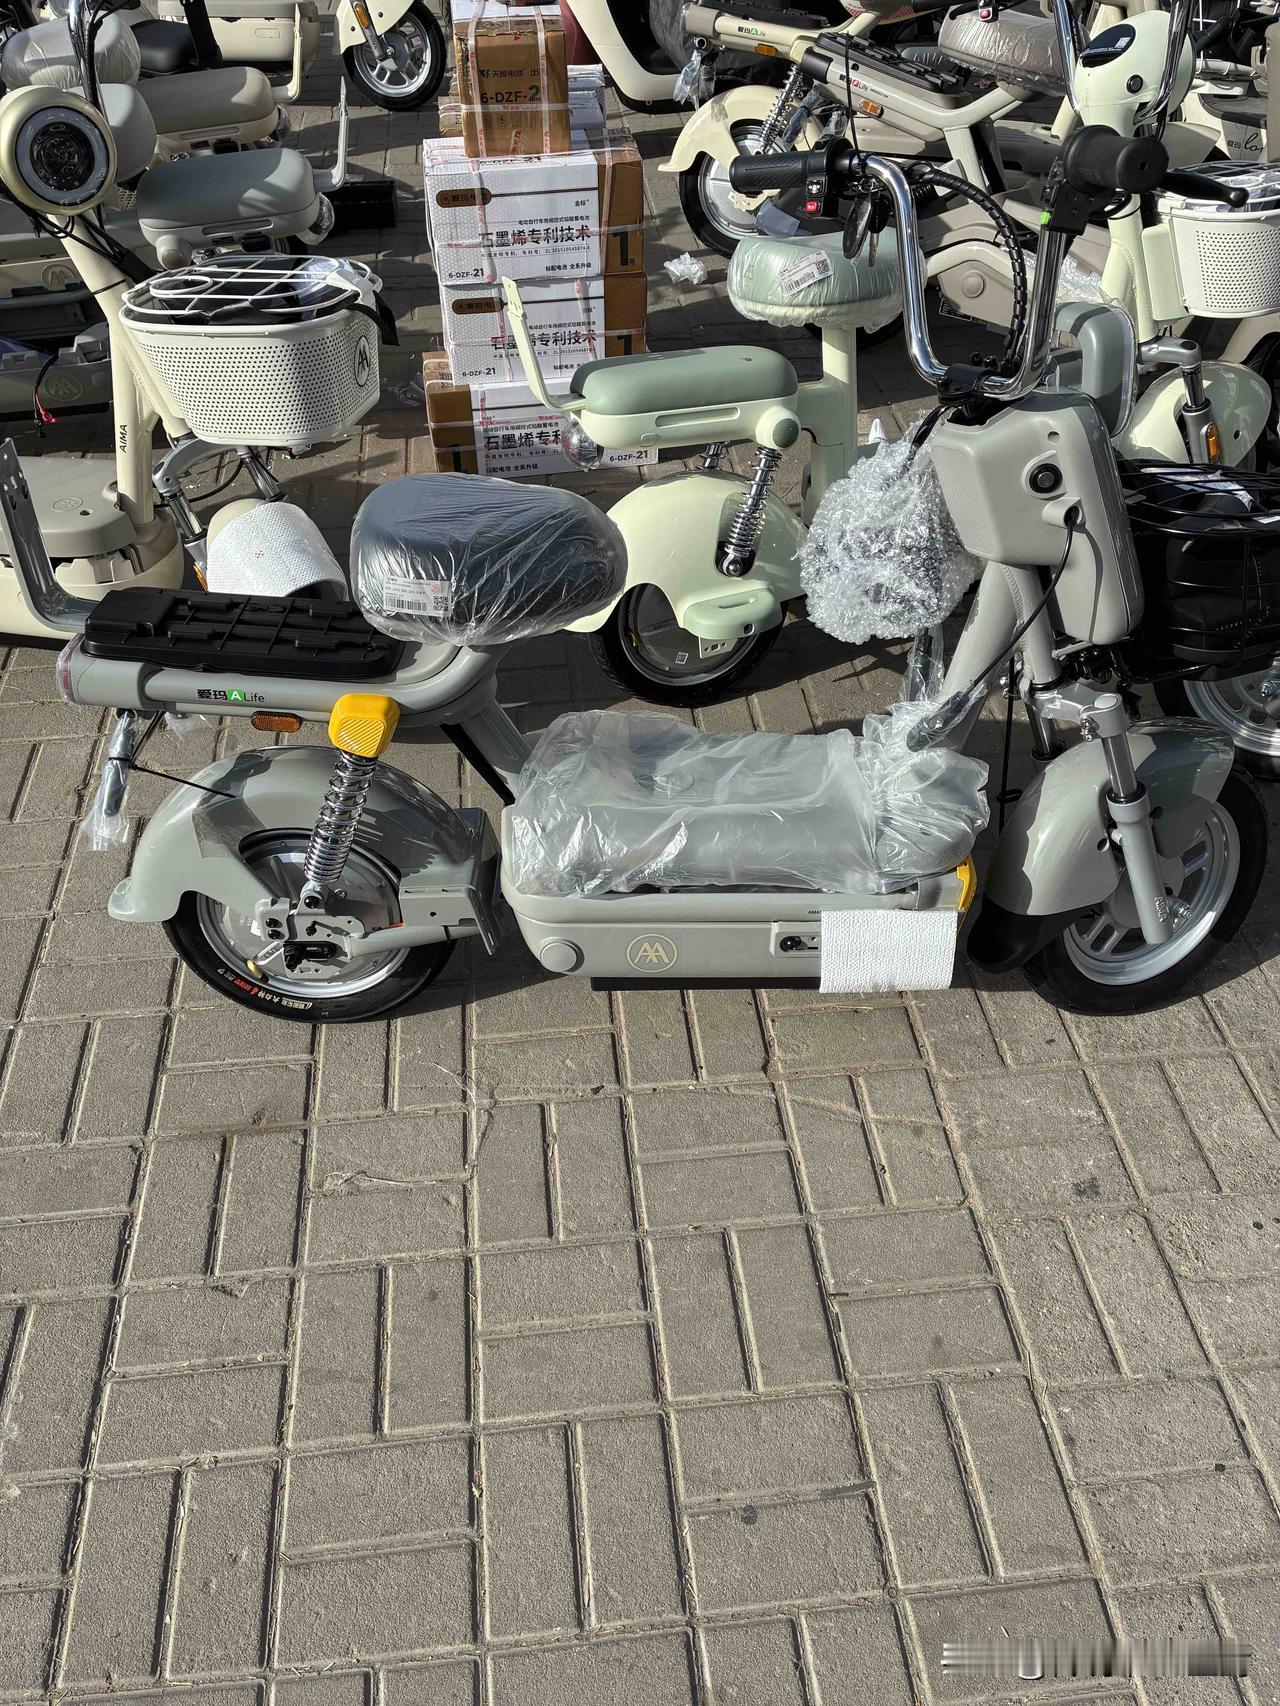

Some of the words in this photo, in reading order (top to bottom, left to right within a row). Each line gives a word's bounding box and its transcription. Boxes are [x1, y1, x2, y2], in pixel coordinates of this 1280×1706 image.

[479, 224, 591, 248] 石墨烯专利技术
[448, 268, 484, 278] 6-DZF-21
[462, 367, 496, 377] 6-DZF-21
[119, 424, 128, 454] AIMA
[610, 450, 648, 461] 6-DZF-21
